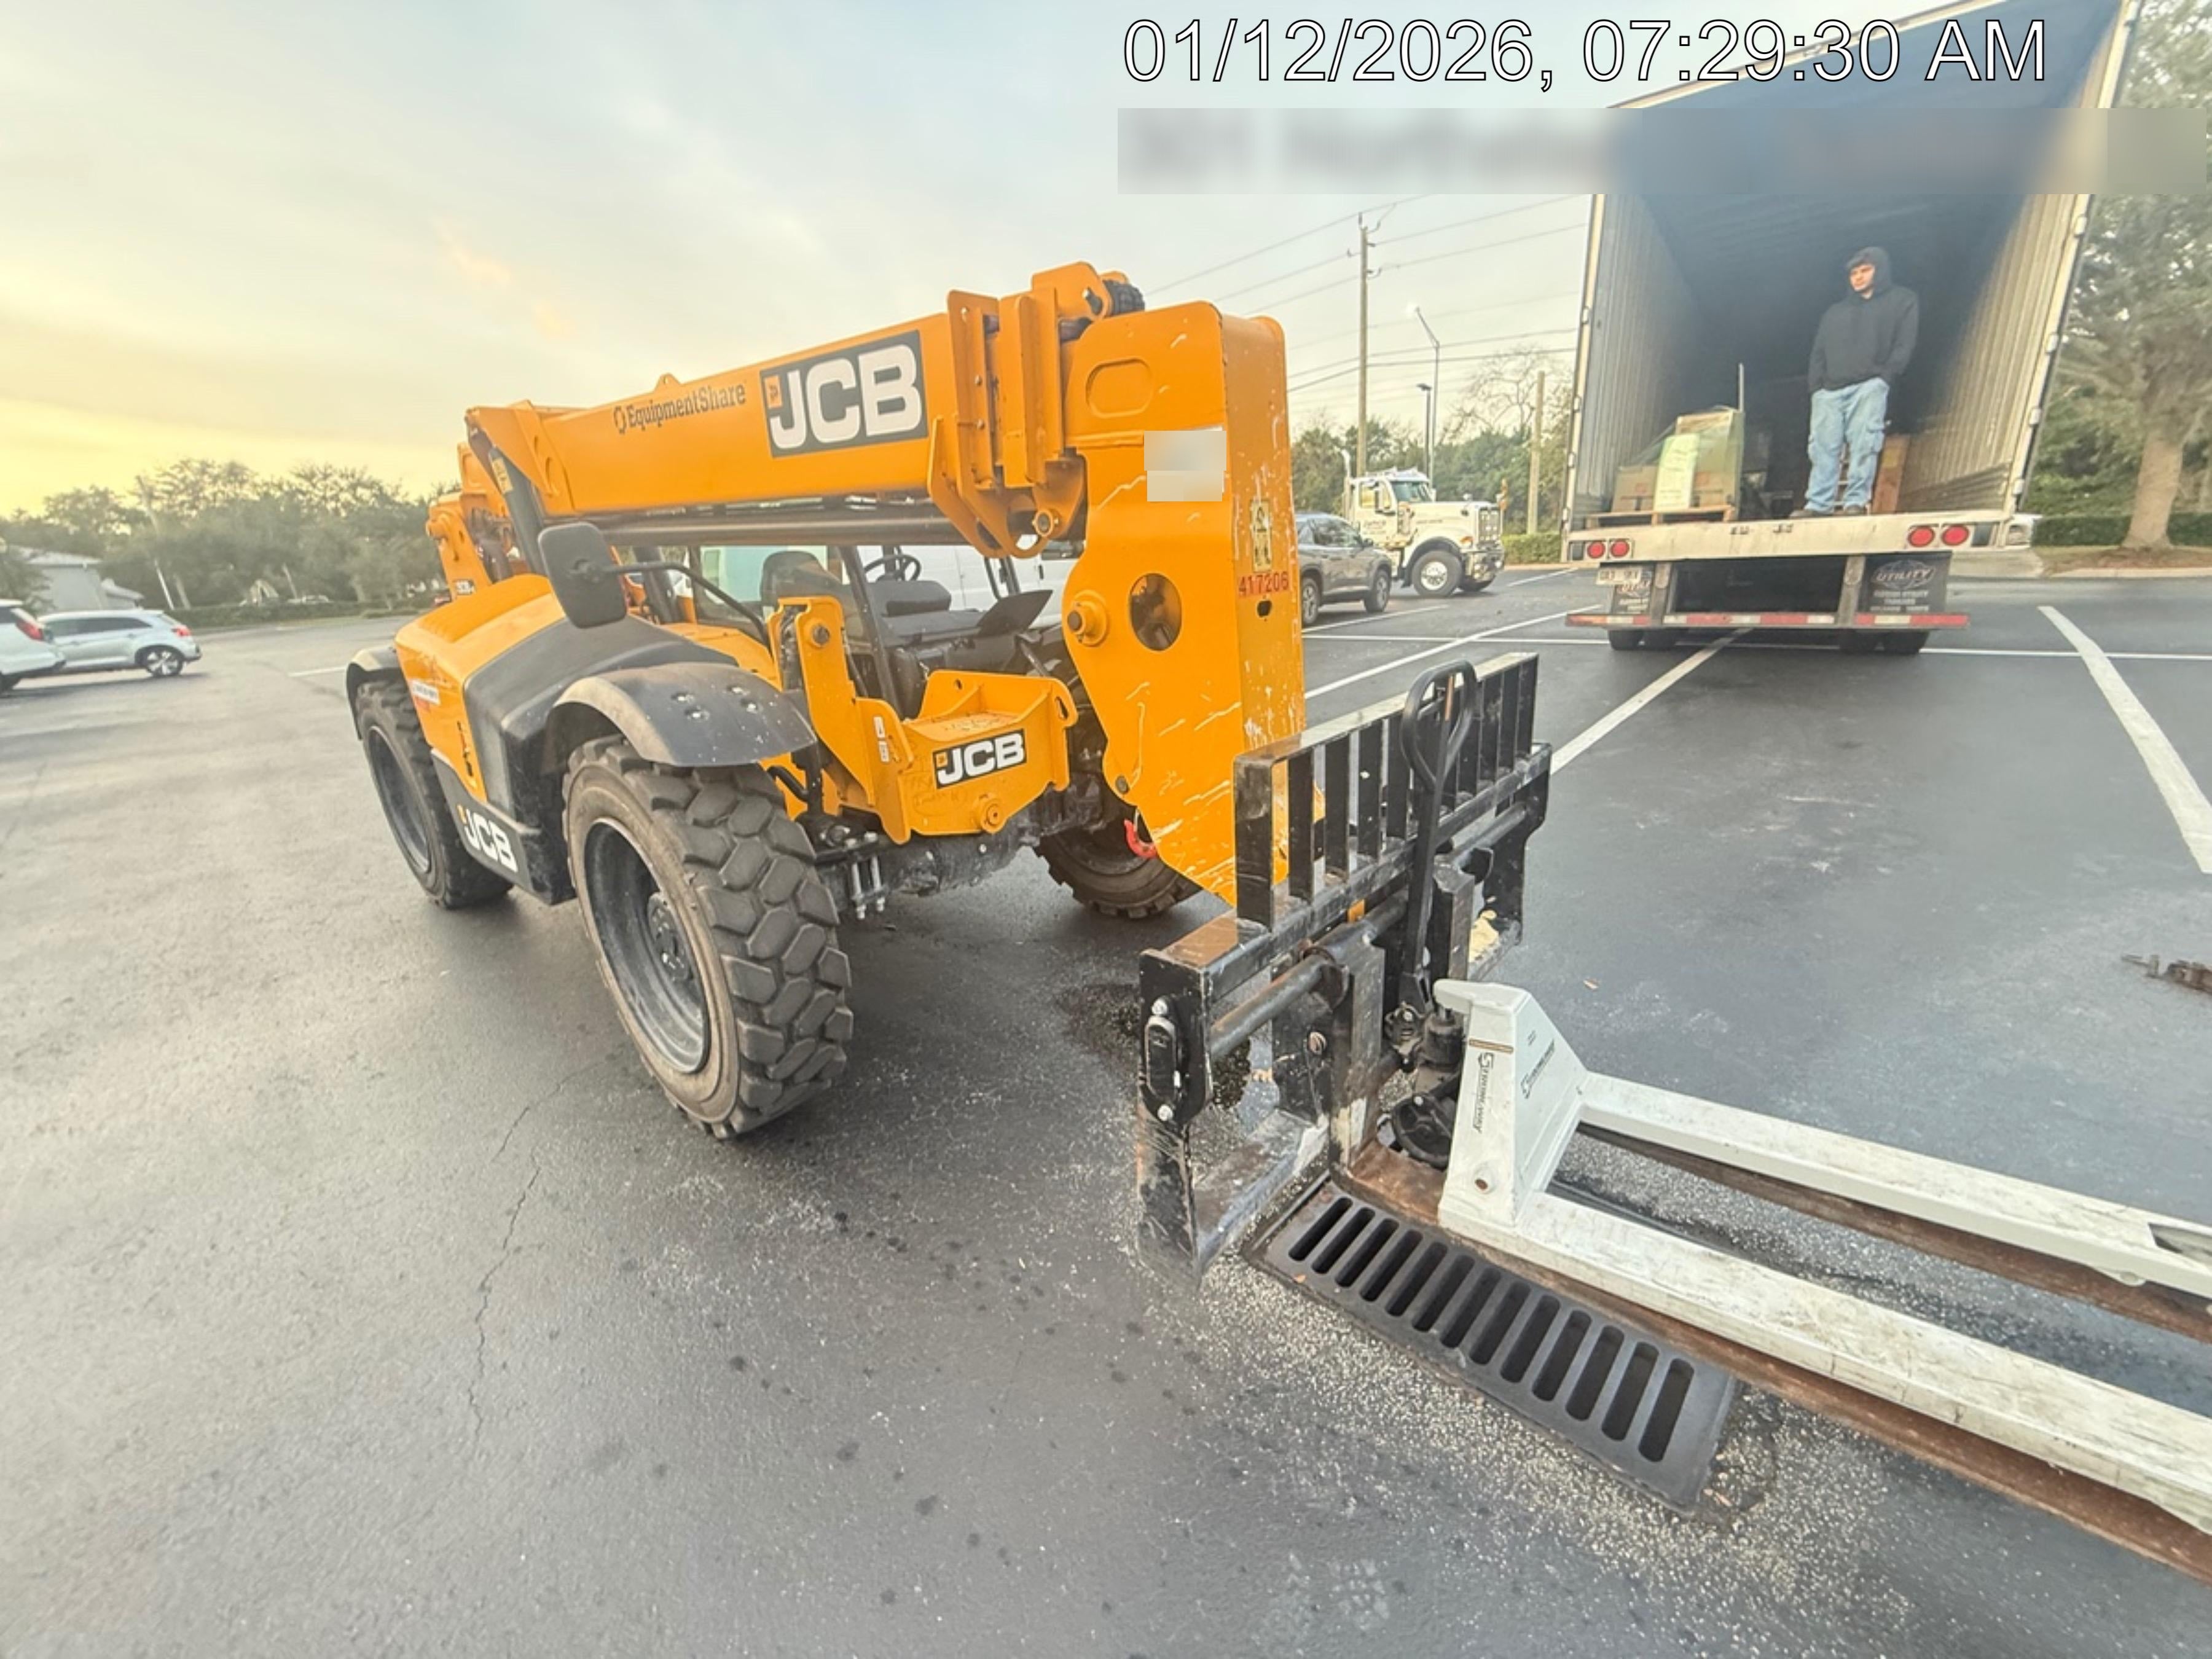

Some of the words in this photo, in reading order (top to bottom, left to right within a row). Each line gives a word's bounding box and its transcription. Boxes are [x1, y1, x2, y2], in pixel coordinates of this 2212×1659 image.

[627, 384, 745, 431] EquipmentShare
[769, 344, 922, 450] JCB
[1238, 571, 1289, 595] 417206
[937, 732, 1025, 785] JCB
[464, 808, 518, 873] JCB
